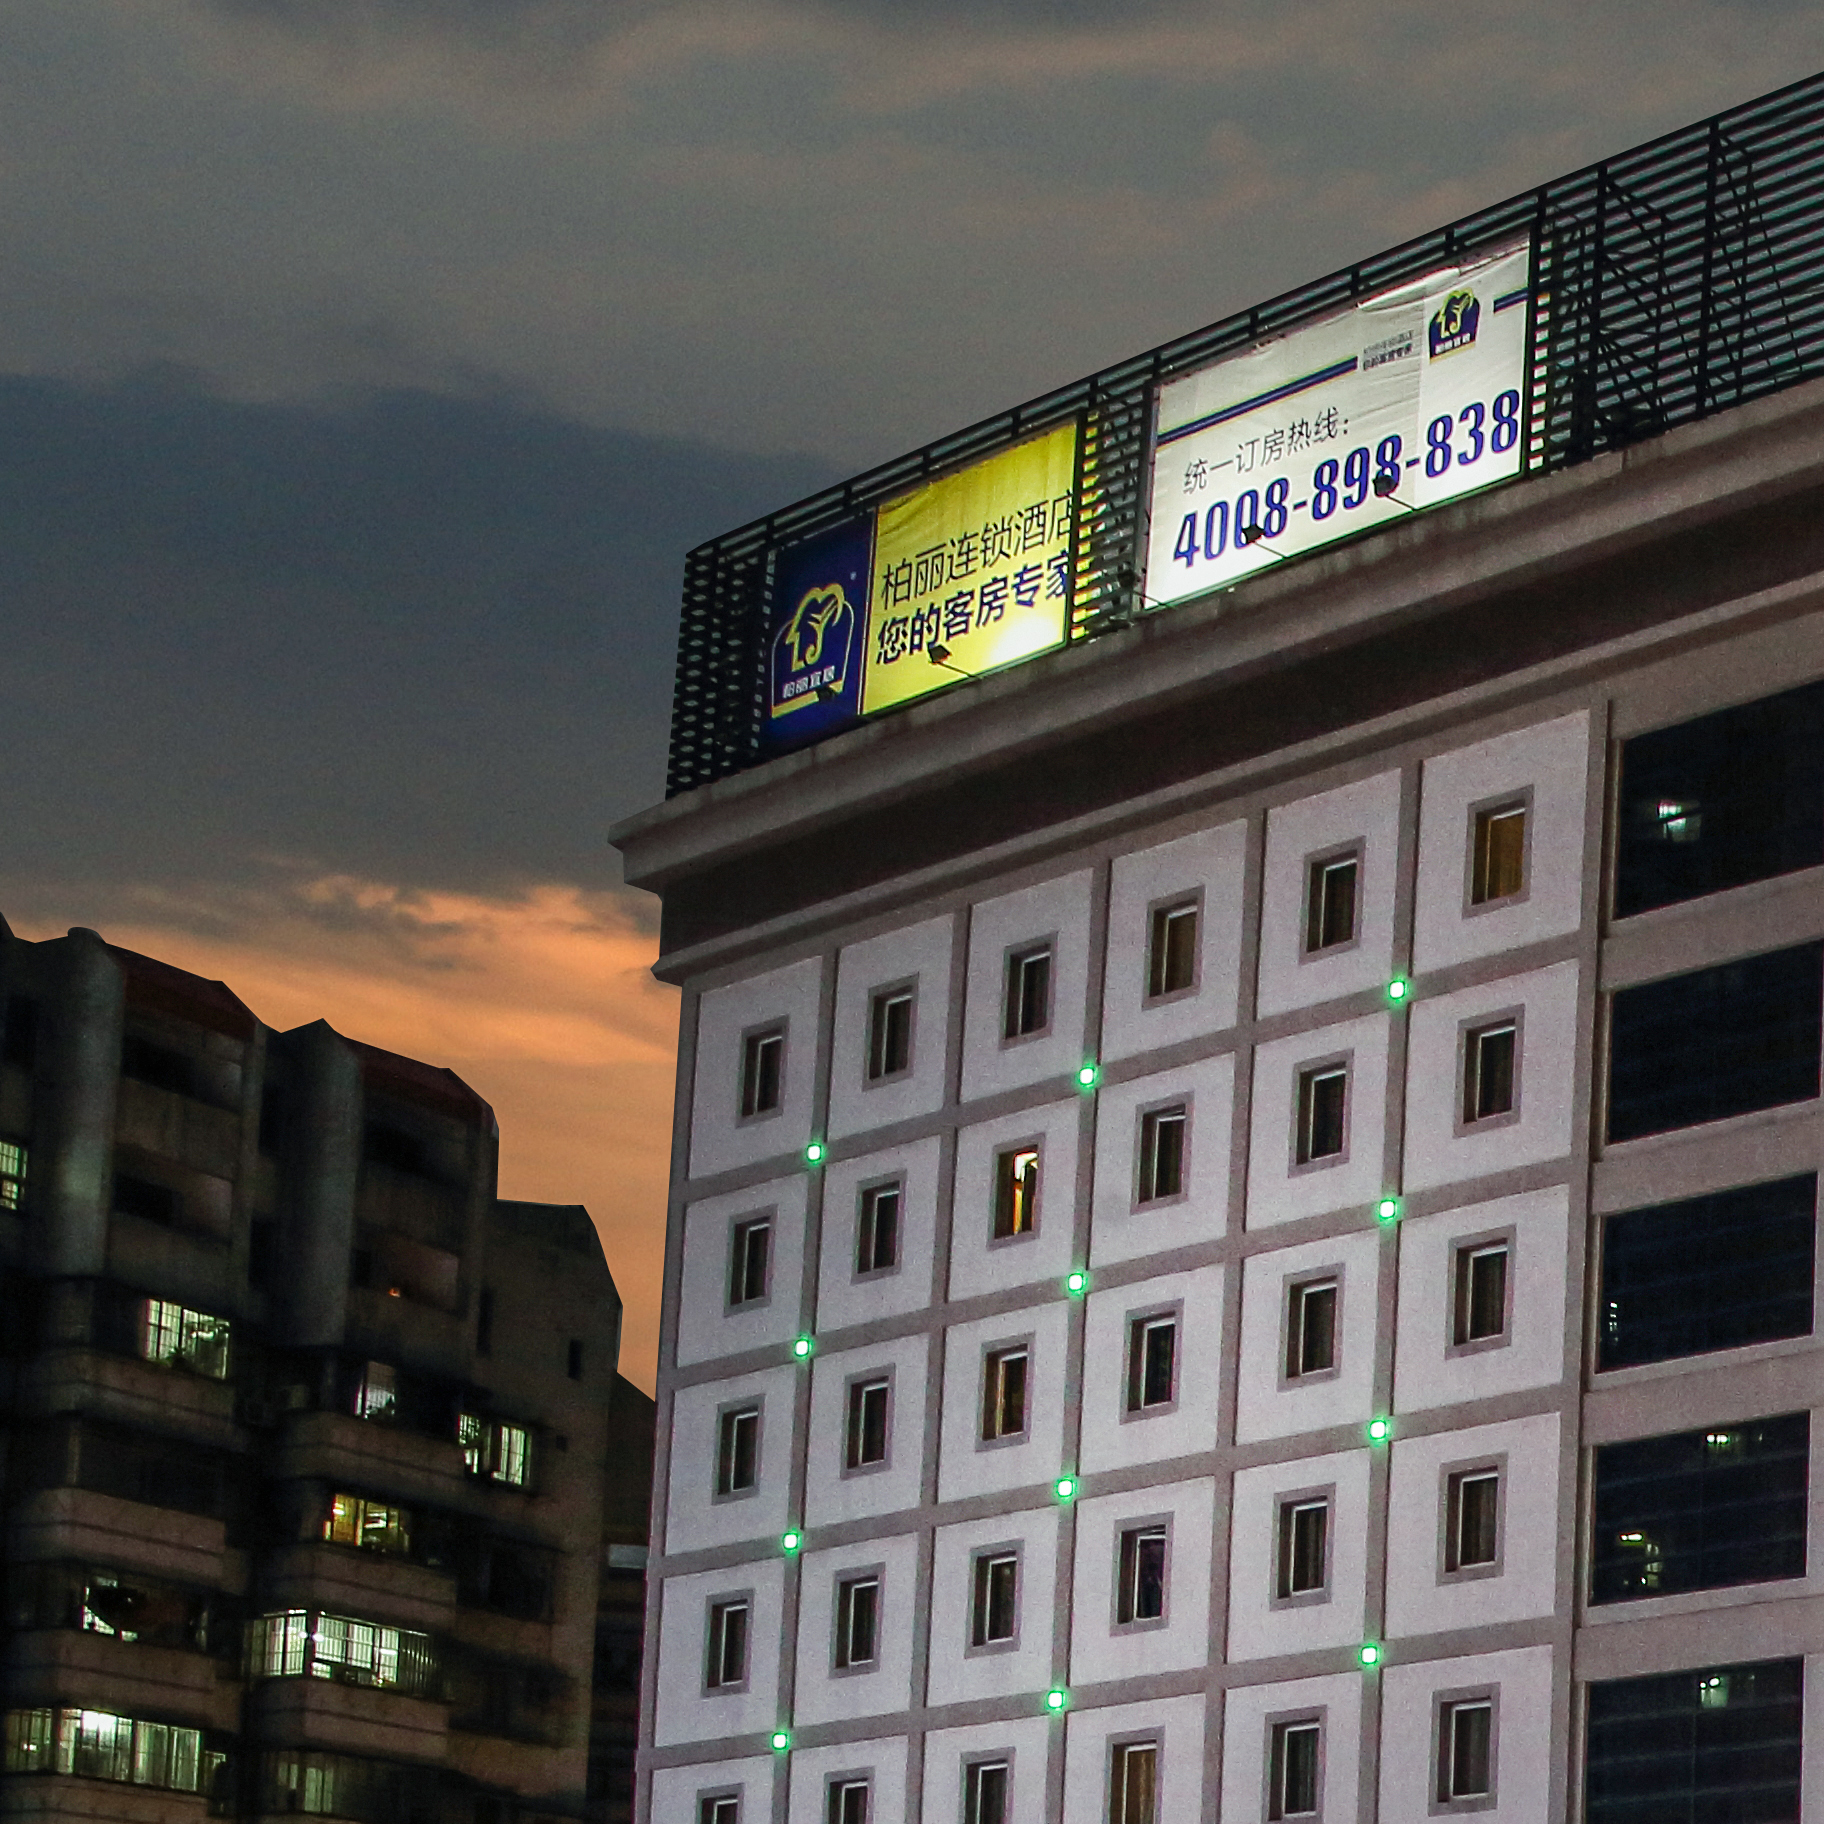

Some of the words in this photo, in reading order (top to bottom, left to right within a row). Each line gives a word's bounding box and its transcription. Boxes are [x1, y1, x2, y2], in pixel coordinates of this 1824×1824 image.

[1174, 389, 1521, 568] 4008-898-838
[877, 550, 1071, 665] 您的客房专家
[881, 489, 1074, 610] 柏丽连锁酒店
